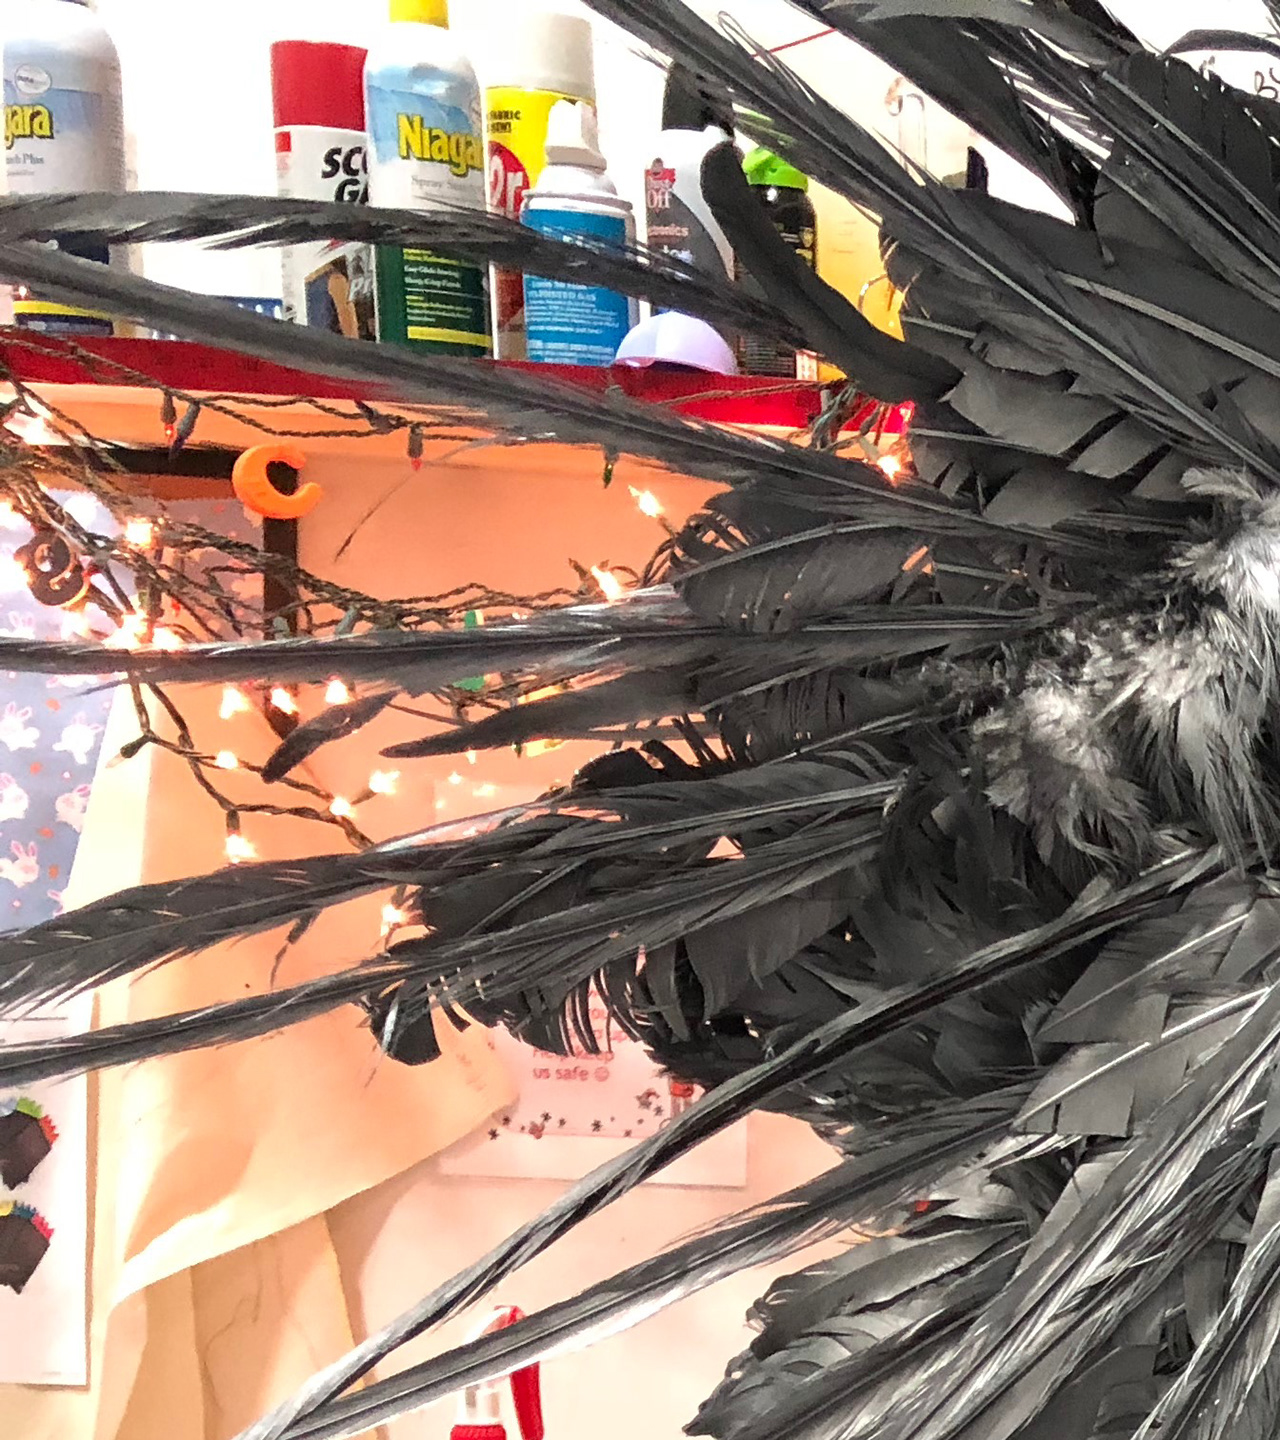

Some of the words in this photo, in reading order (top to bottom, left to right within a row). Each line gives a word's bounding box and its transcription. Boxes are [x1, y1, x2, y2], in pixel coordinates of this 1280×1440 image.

[321, 146, 367, 178] SC
[533, 1067, 550, 1079] us
[555, 1065, 588, 1080] safe
